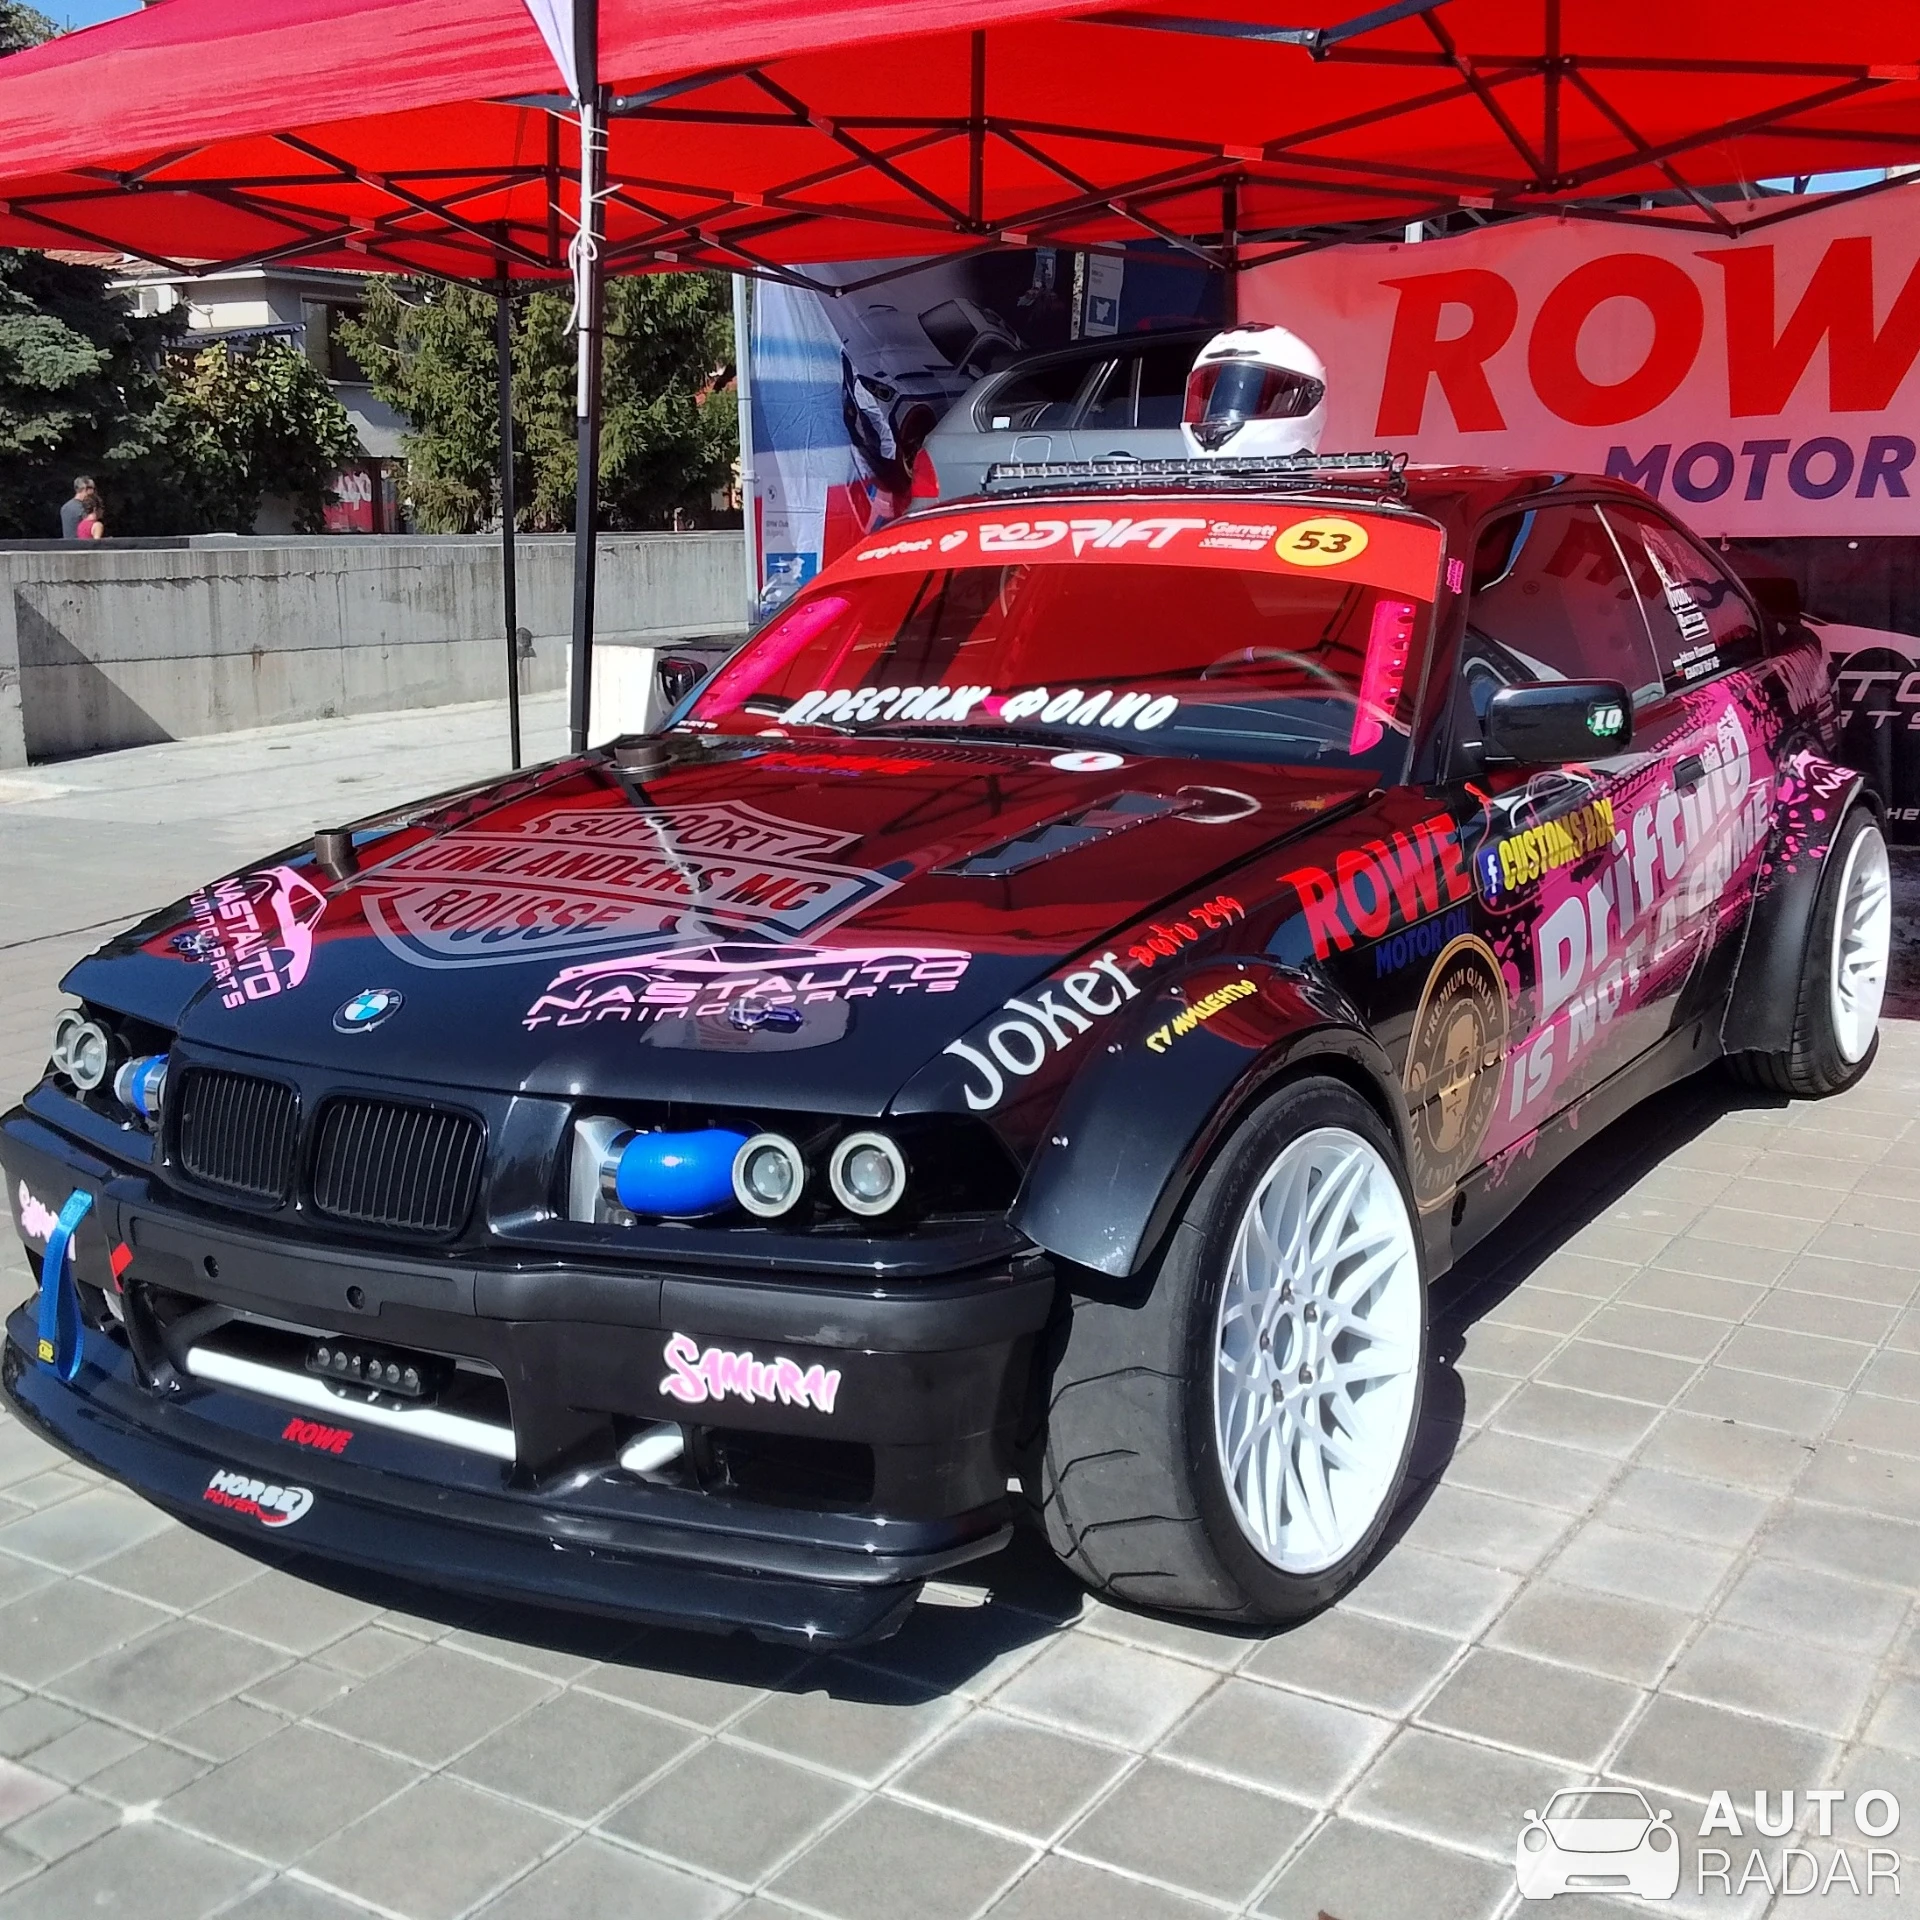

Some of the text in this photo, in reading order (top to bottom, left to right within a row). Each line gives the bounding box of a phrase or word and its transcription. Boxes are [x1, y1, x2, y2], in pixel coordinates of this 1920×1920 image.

[1374, 236, 1920, 437] ROW
[1604, 434, 1917, 503] MOTOR
[1292, 530, 1353, 553] 53
[1000, 688, 1180, 731] ФОЛИО
[1592, 708, 1623, 731] 10
[553, 814, 786, 856] SUPPORT
[1498, 811, 1584, 890] CUSTOMS
[399, 845, 832, 911] LOWLANDERS MC
[1276, 812, 1471, 961] ROWE
[211, 876, 282, 1001] NASTAUTO
[414, 888, 636, 943] ROUSSE
[1375, 906, 1472, 979] MOTOR OIL
[1509, 1027, 1554, 1123] IS
[1568, 930, 1646, 1062] NOT
[1688, 785, 1769, 921] CRIME
[527, 960, 971, 1017] NASTAUTO
[1424, 966, 1498, 1048] PREMIUM QUALITY
[942, 951, 1141, 1111] Joker
[659, 1332, 842, 1414] SAMURAI
[282, 1417, 354, 1454] ROWE
[203, 1488, 259, 1515] POWER
[208, 1469, 303, 1513] HORSE
